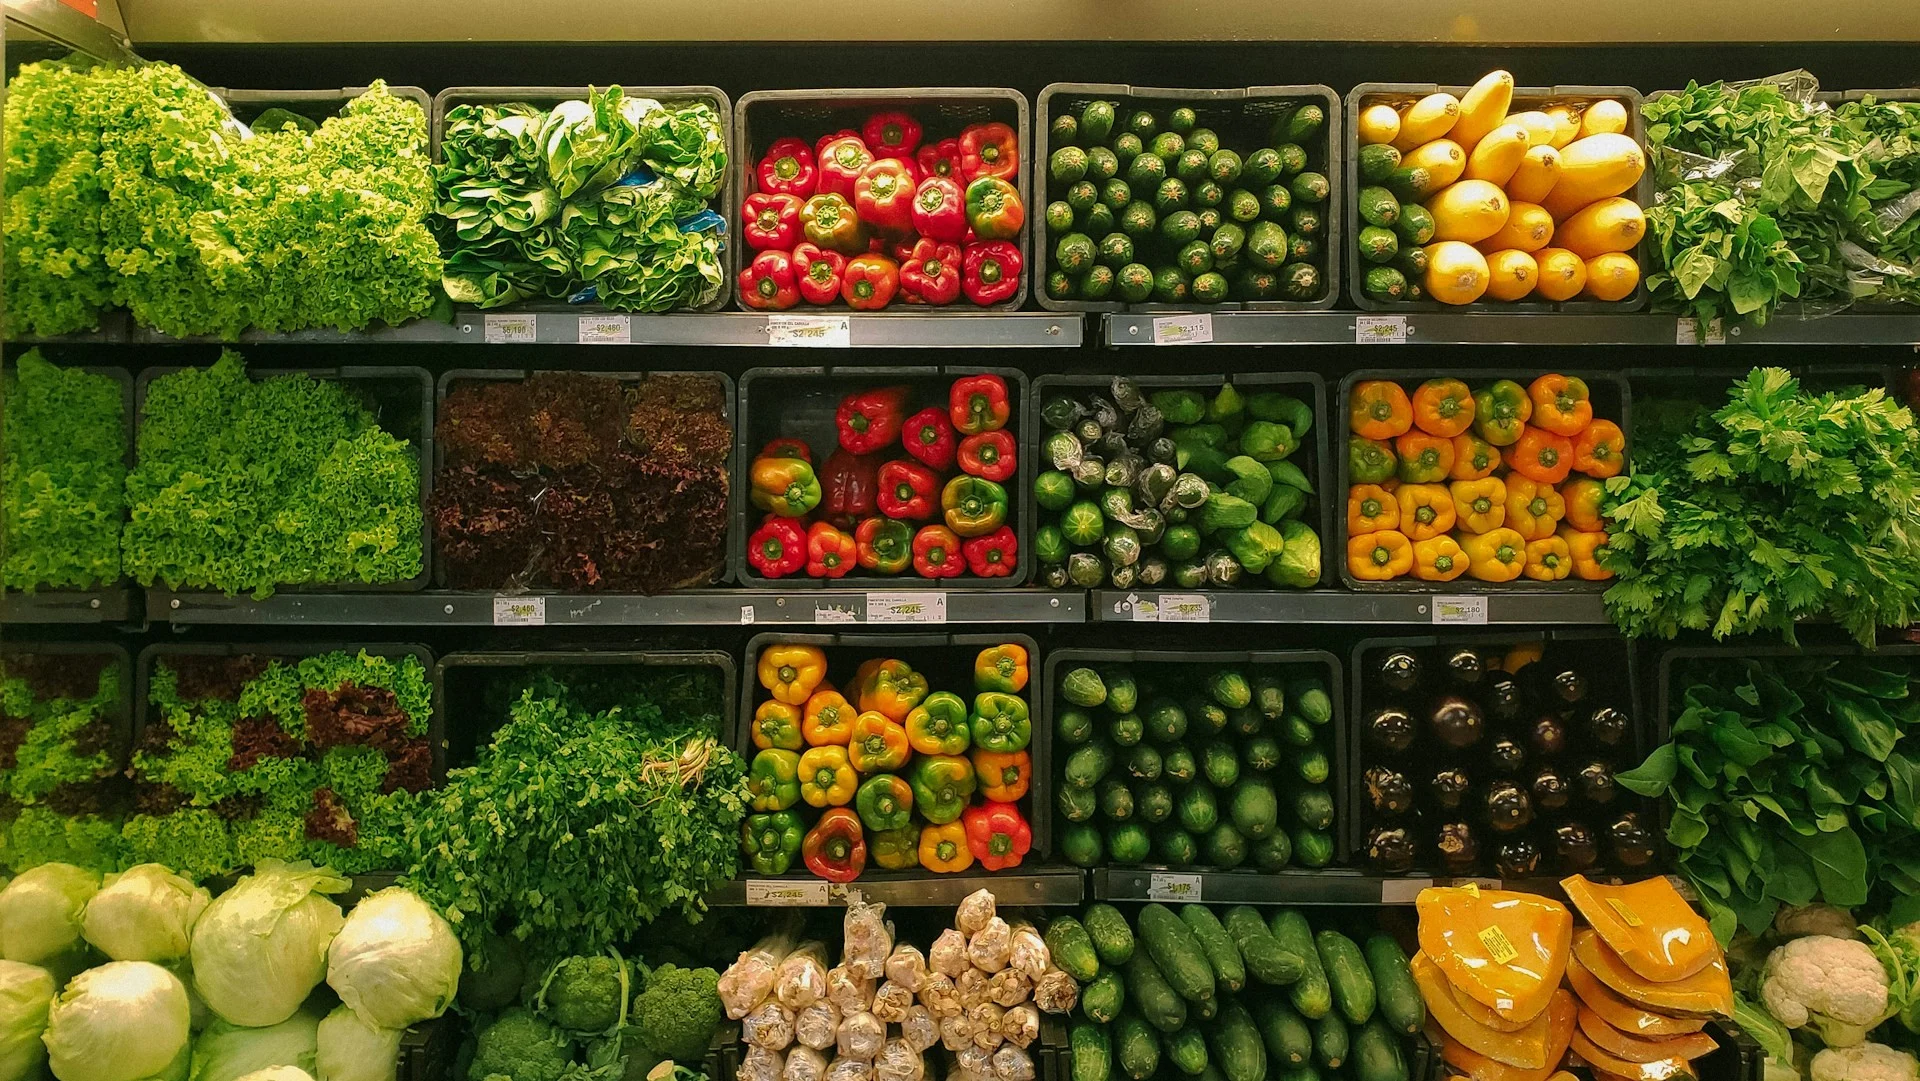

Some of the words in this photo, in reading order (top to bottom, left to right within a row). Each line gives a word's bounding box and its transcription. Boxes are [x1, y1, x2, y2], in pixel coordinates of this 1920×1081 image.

[840, 322, 848, 330] A
[936, 598, 944, 606] A
[890, 606, 922, 615] $2,245
[771, 891, 804, 899] $2,245
